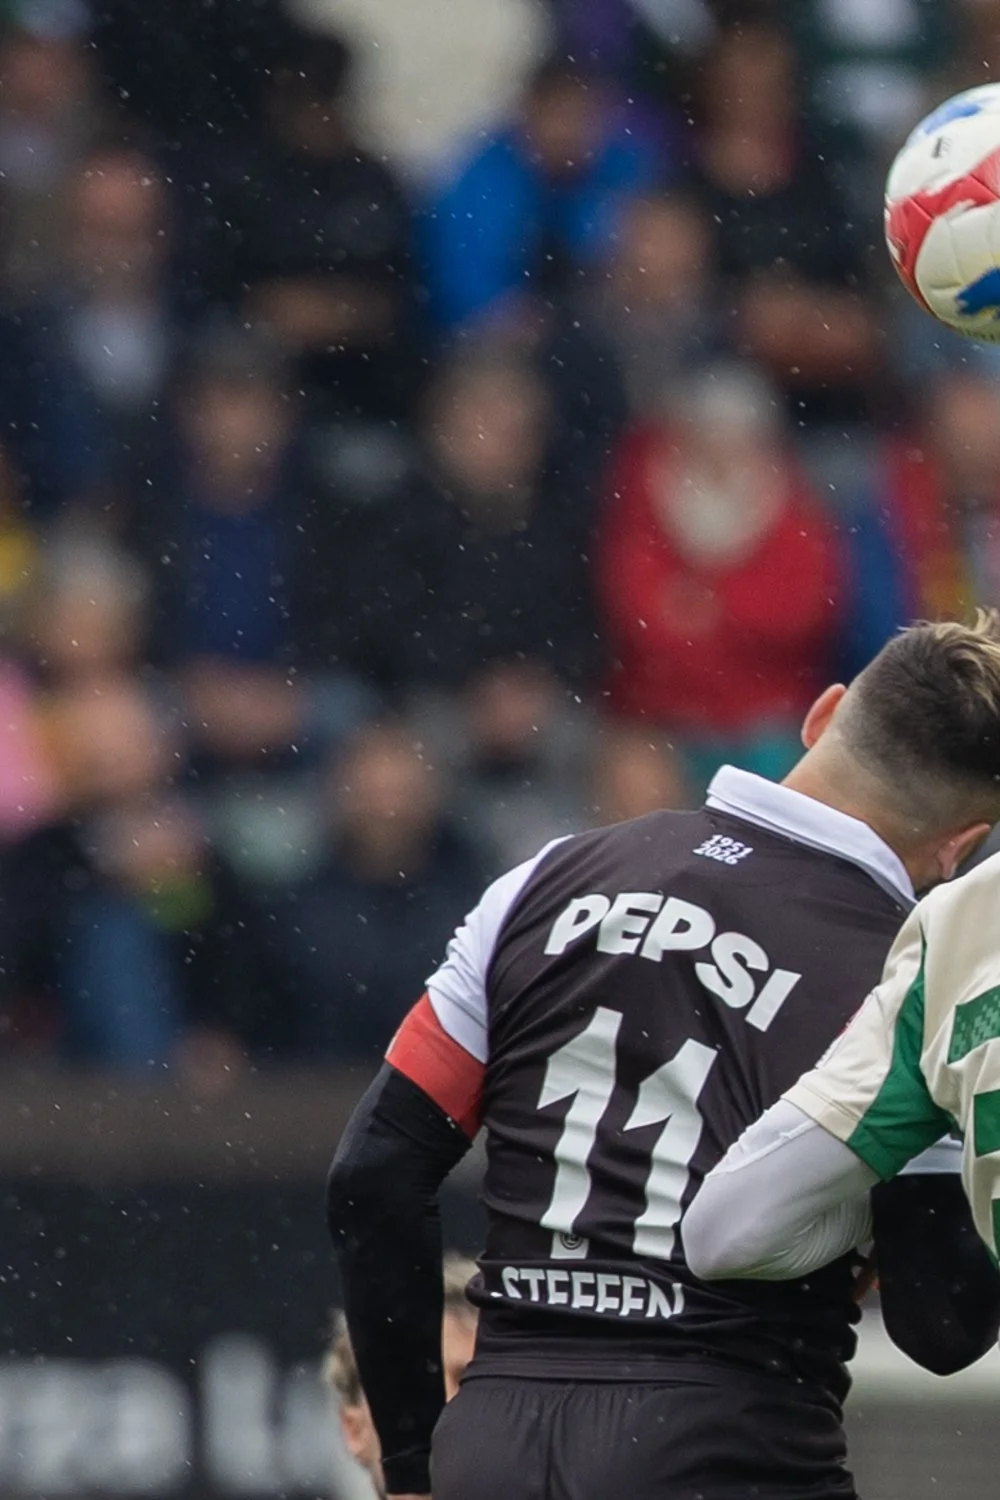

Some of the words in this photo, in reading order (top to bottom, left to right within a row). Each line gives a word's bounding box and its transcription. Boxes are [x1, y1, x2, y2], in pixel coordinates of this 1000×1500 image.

[692, 843, 739, 865] 2026
[543, 891, 802, 1033] PEPSI
[536, 1005, 719, 1261] 11
[490, 1265, 685, 1319] STEFFEN
